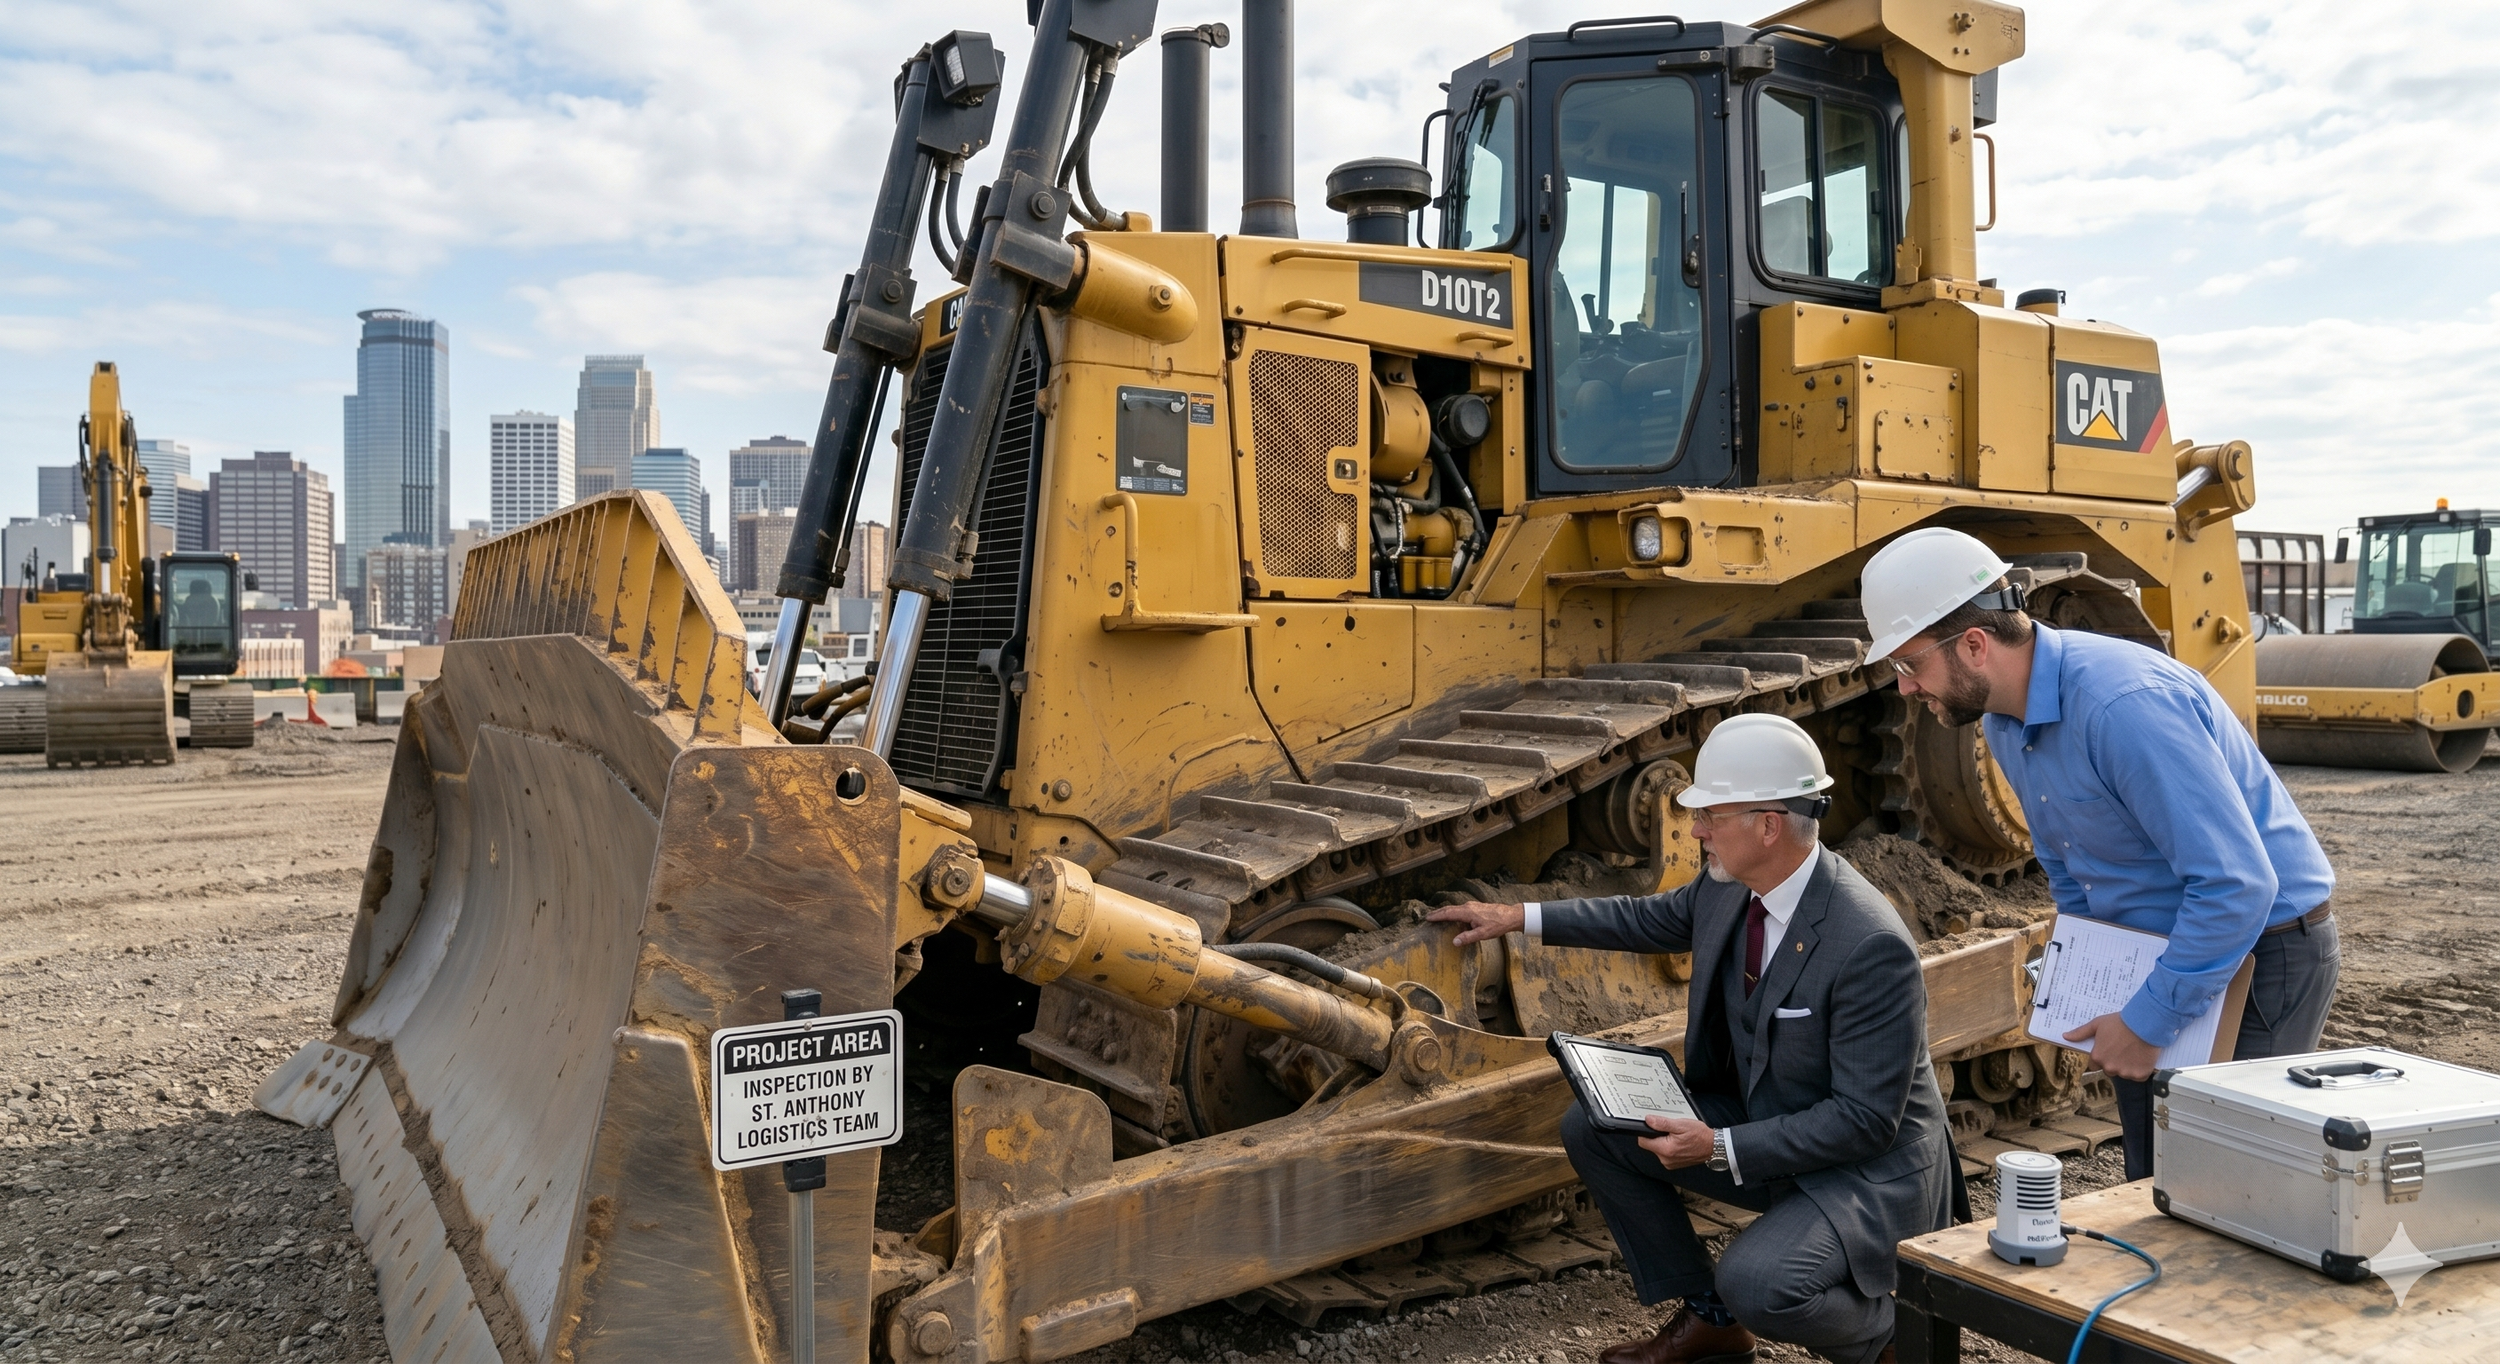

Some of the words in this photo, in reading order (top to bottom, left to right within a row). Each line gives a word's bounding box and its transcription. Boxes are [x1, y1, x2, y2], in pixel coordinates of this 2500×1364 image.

[949, 295, 968, 330] CA
[1422, 270, 1501, 321] D10T2
[2066, 372, 2133, 441] CAT
[732, 1036, 825, 1068] PROJECT
[830, 1029, 883, 1056] AREA
[743, 1068, 846, 1099] INSPECTION
[852, 1065, 874, 1084] BY
[752, 1103, 777, 1122] ST.
[784, 1089, 866, 1118] ANTHONY
[738, 1119, 827, 1149] LOGISTICS
[833, 1111, 879, 1135] TEAM
